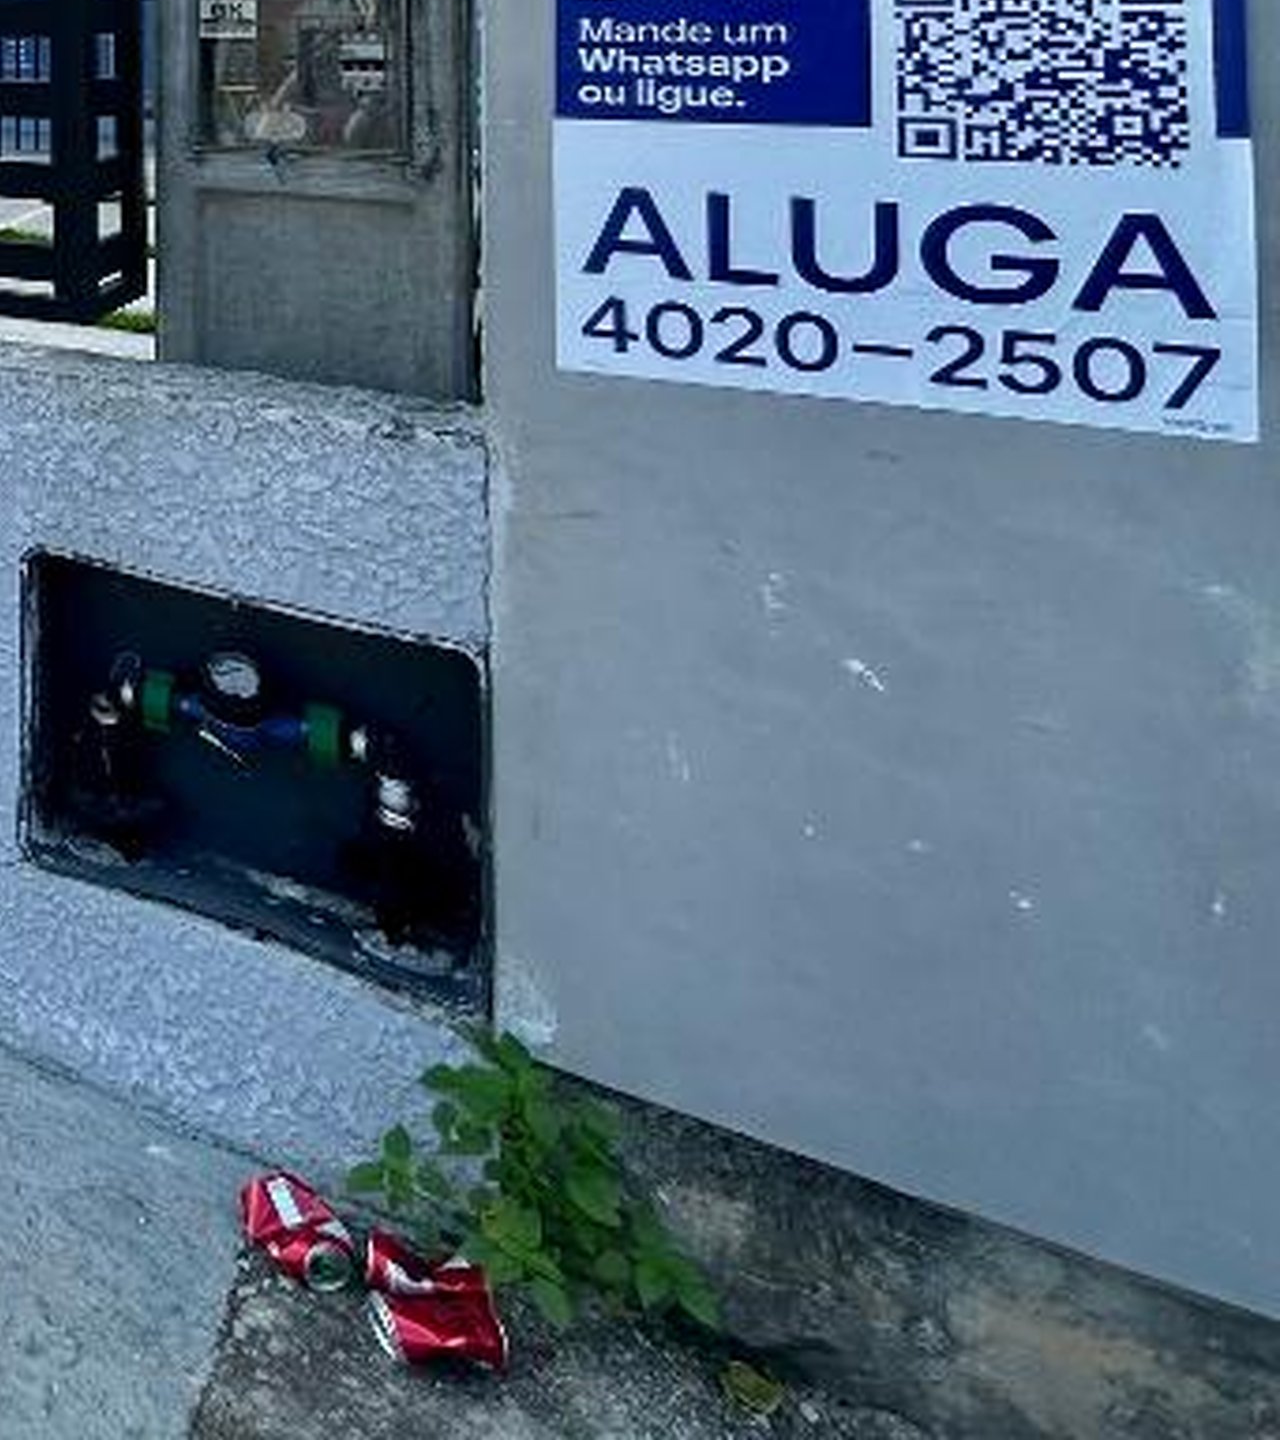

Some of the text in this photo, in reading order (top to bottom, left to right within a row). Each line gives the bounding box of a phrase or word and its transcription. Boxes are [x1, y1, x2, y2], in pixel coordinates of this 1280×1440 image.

[578, 17, 788, 44] Mande um
[578, 48, 790, 83] Whatsapp
[578, 78, 746, 113] ou ligue.
[580, 186, 1219, 321] ALUGA
[581, 295, 1222, 410] 4020-2507
